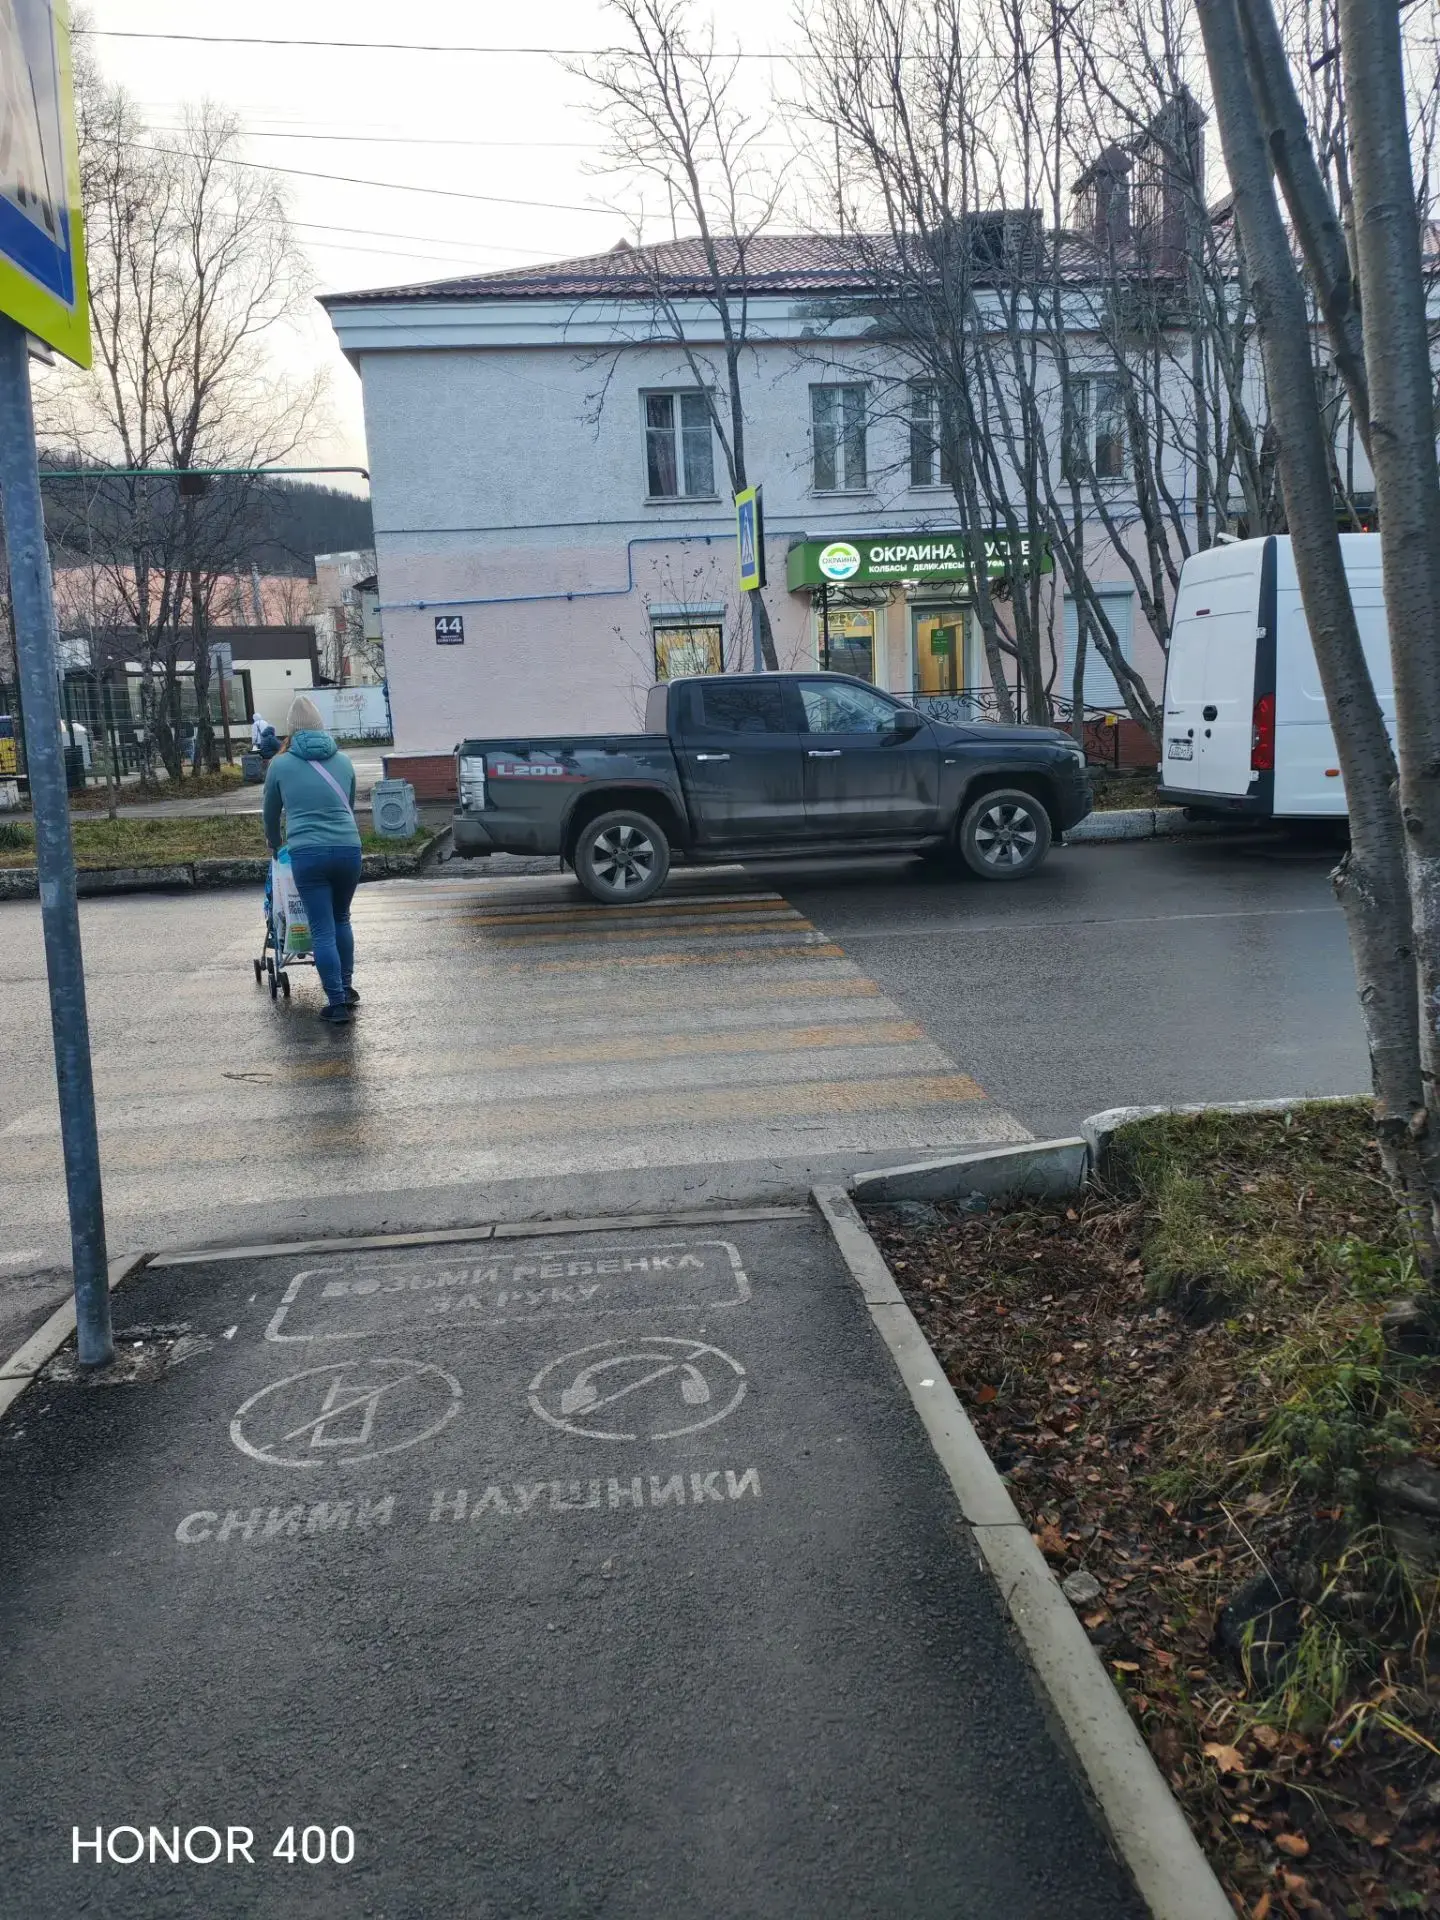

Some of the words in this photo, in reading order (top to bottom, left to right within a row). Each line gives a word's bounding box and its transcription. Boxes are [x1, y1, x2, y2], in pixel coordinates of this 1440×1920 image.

[869, 544, 957, 562] ОКРАИНА
[869, 565, 907, 573] КОЛБАСЫ
[913, 561, 965, 572] ДЕЛИКАТЕСЫ
[436, 617, 462, 633] 44
[497, 765, 563, 776] L200
[175, 1496, 397, 1544] СНИМИ
[429, 1467, 763, 1522] НАУШНИКИ
